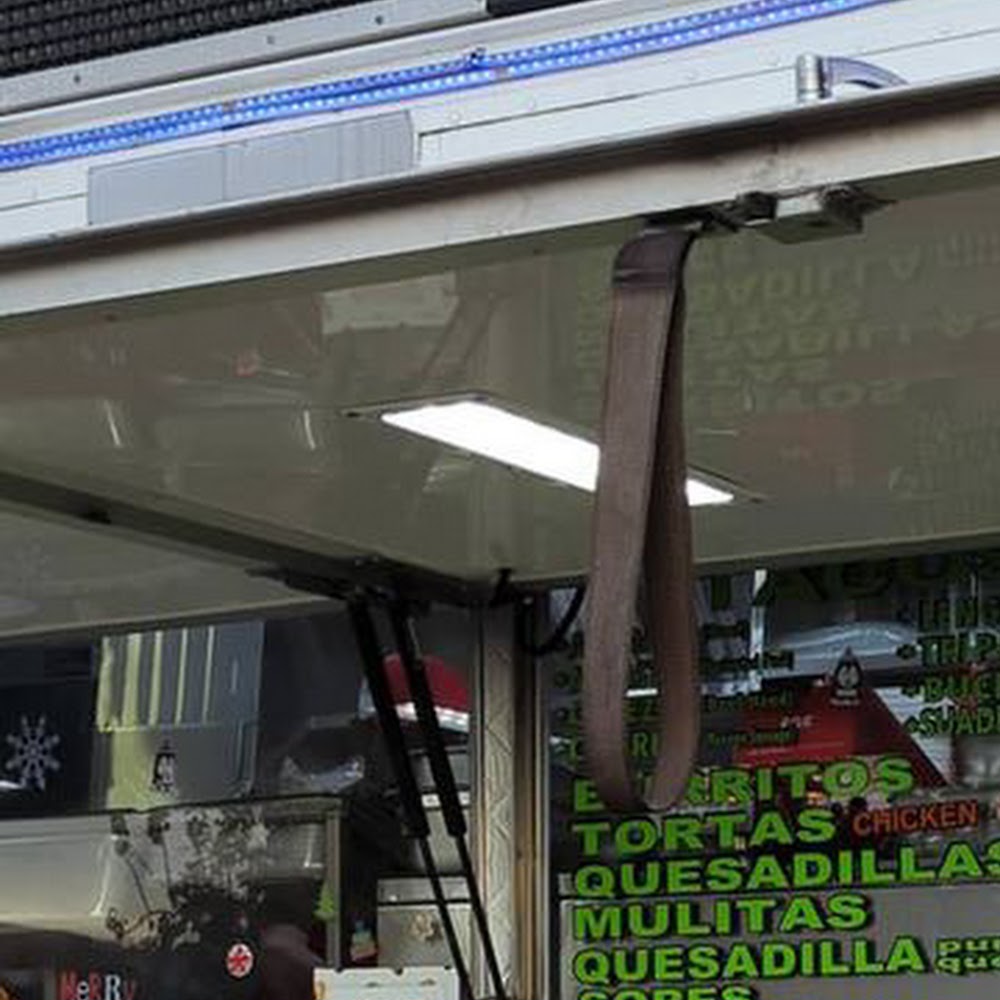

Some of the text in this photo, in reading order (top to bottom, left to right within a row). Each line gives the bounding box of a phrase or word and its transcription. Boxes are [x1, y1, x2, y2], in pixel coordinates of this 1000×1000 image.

[573, 756, 915, 812] BRITOS
[572, 808, 837, 858] TORTAS
[853, 802, 979, 837] CHICKEN
[573, 893, 869, 941] MULITAS
[573, 936, 925, 986] QUESADILLA
